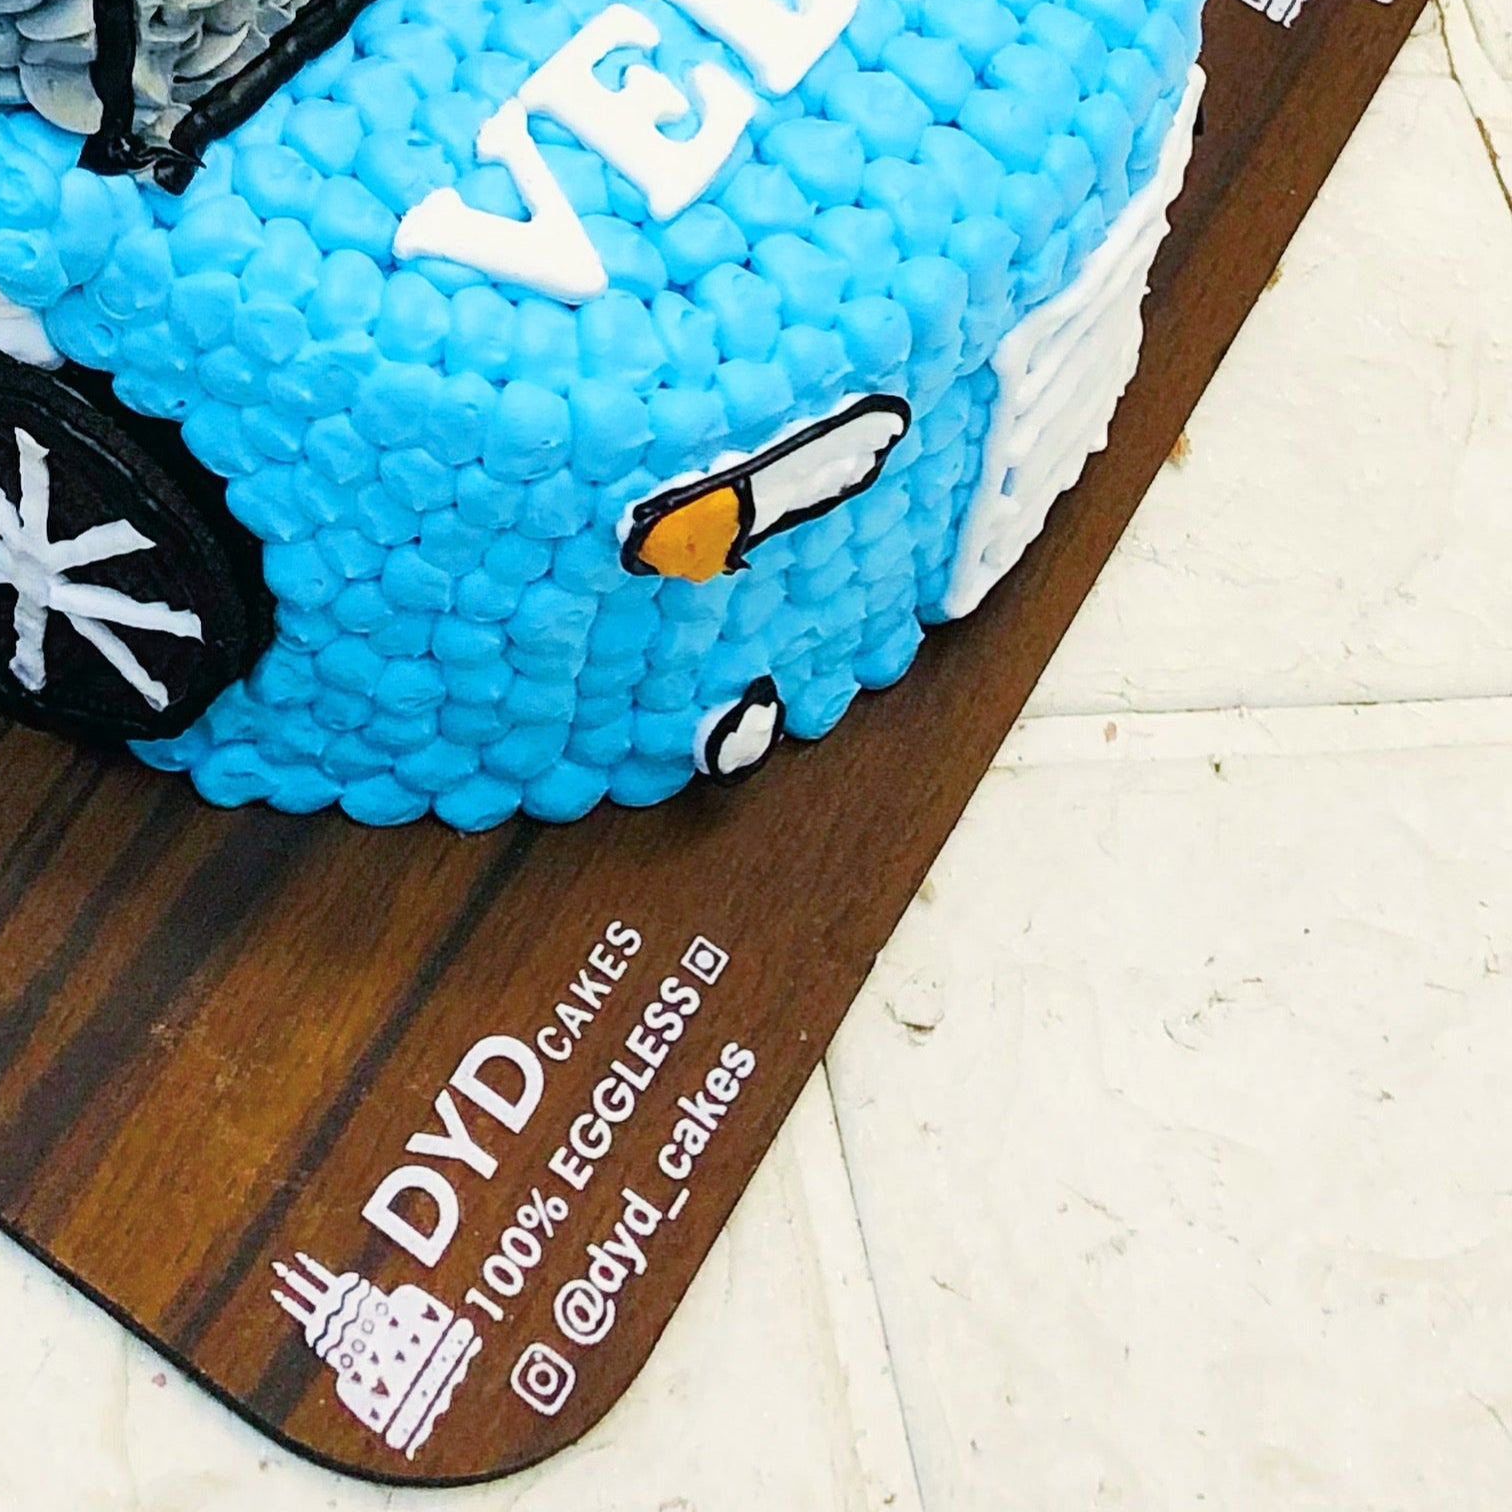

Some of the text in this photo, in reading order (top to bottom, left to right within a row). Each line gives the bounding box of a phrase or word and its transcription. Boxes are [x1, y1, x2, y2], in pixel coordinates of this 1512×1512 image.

[361, 920, 642, 1268] DYD CAKES
[465, 976, 701, 1322] 100% EGGLESS
